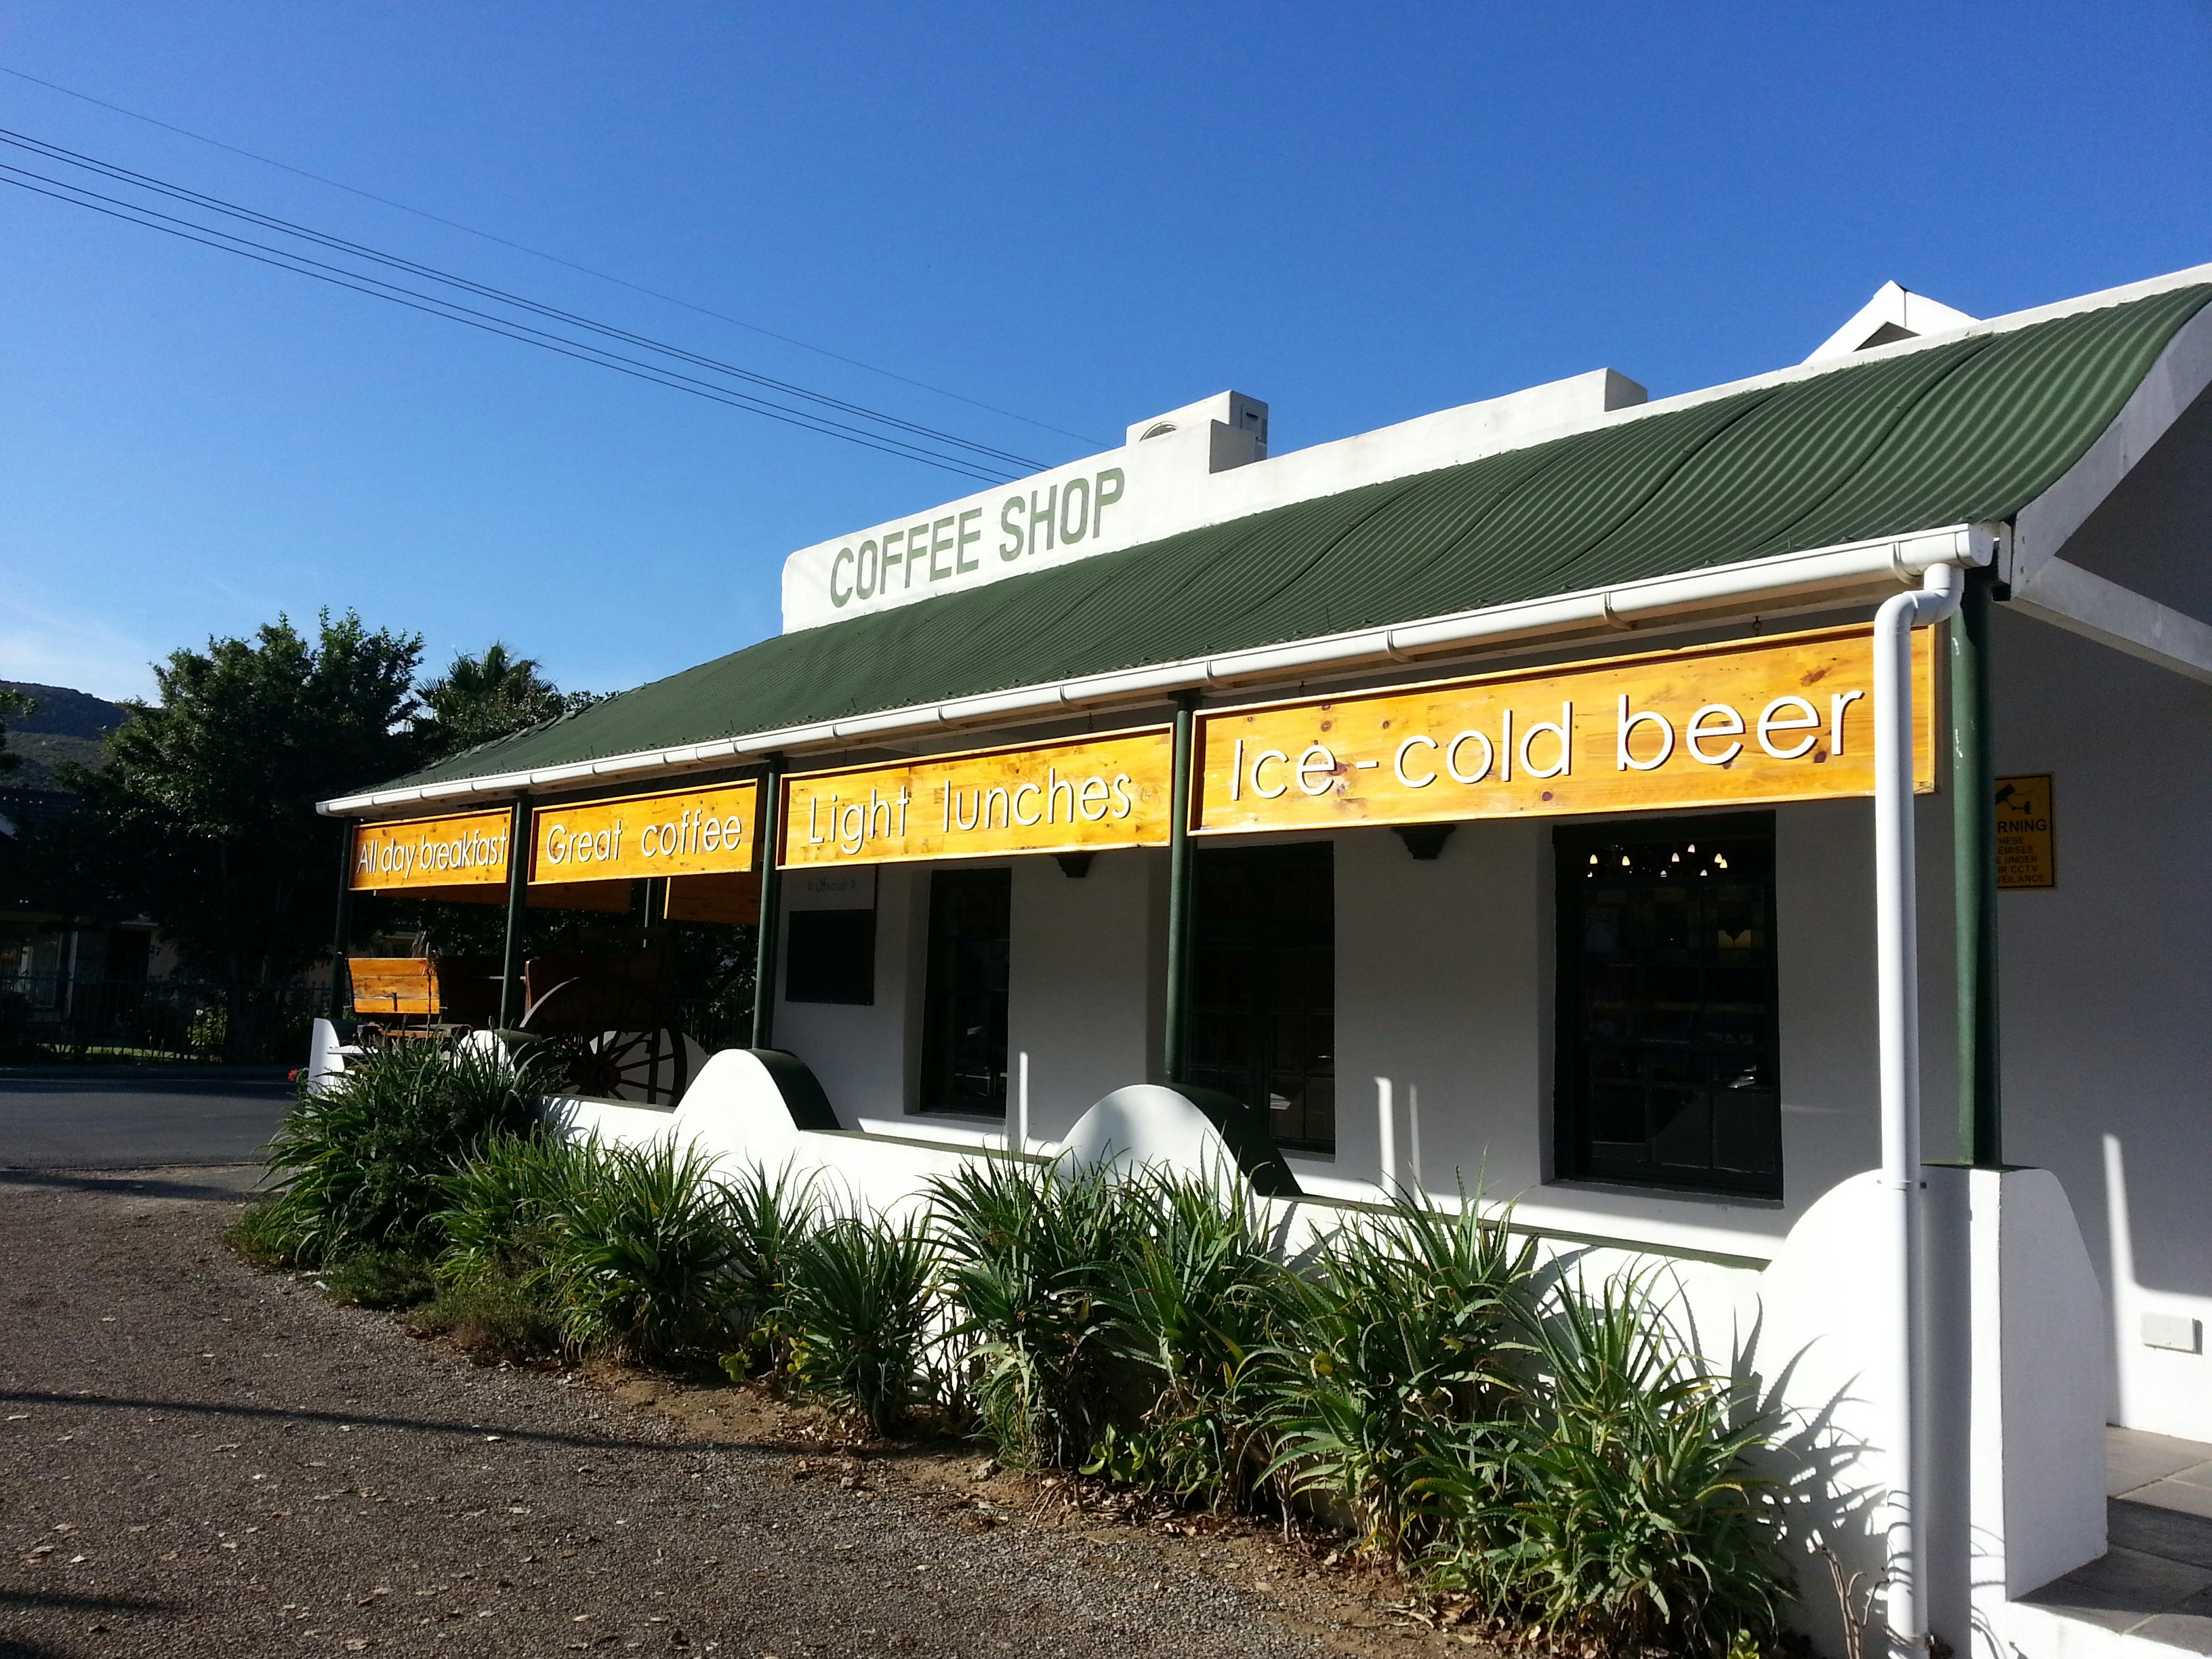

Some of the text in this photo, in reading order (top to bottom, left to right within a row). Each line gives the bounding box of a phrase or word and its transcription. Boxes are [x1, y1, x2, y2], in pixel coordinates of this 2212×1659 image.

[830, 468, 1125, 608] COFFEE SHOP
[1231, 690, 1864, 801] Ice-cold beer
[809, 768, 1132, 855] Light lunches
[1998, 819, 2047, 834] RNING
[356, 827, 508, 879] All day breakfast
[546, 809, 742, 864] Great coffee
[1996, 836, 2024, 845] HESE
[1998, 845, 2034, 855] EMISES
[2005, 855, 2038, 864] UNDER
[2011, 865, 2039, 874] CCTV
